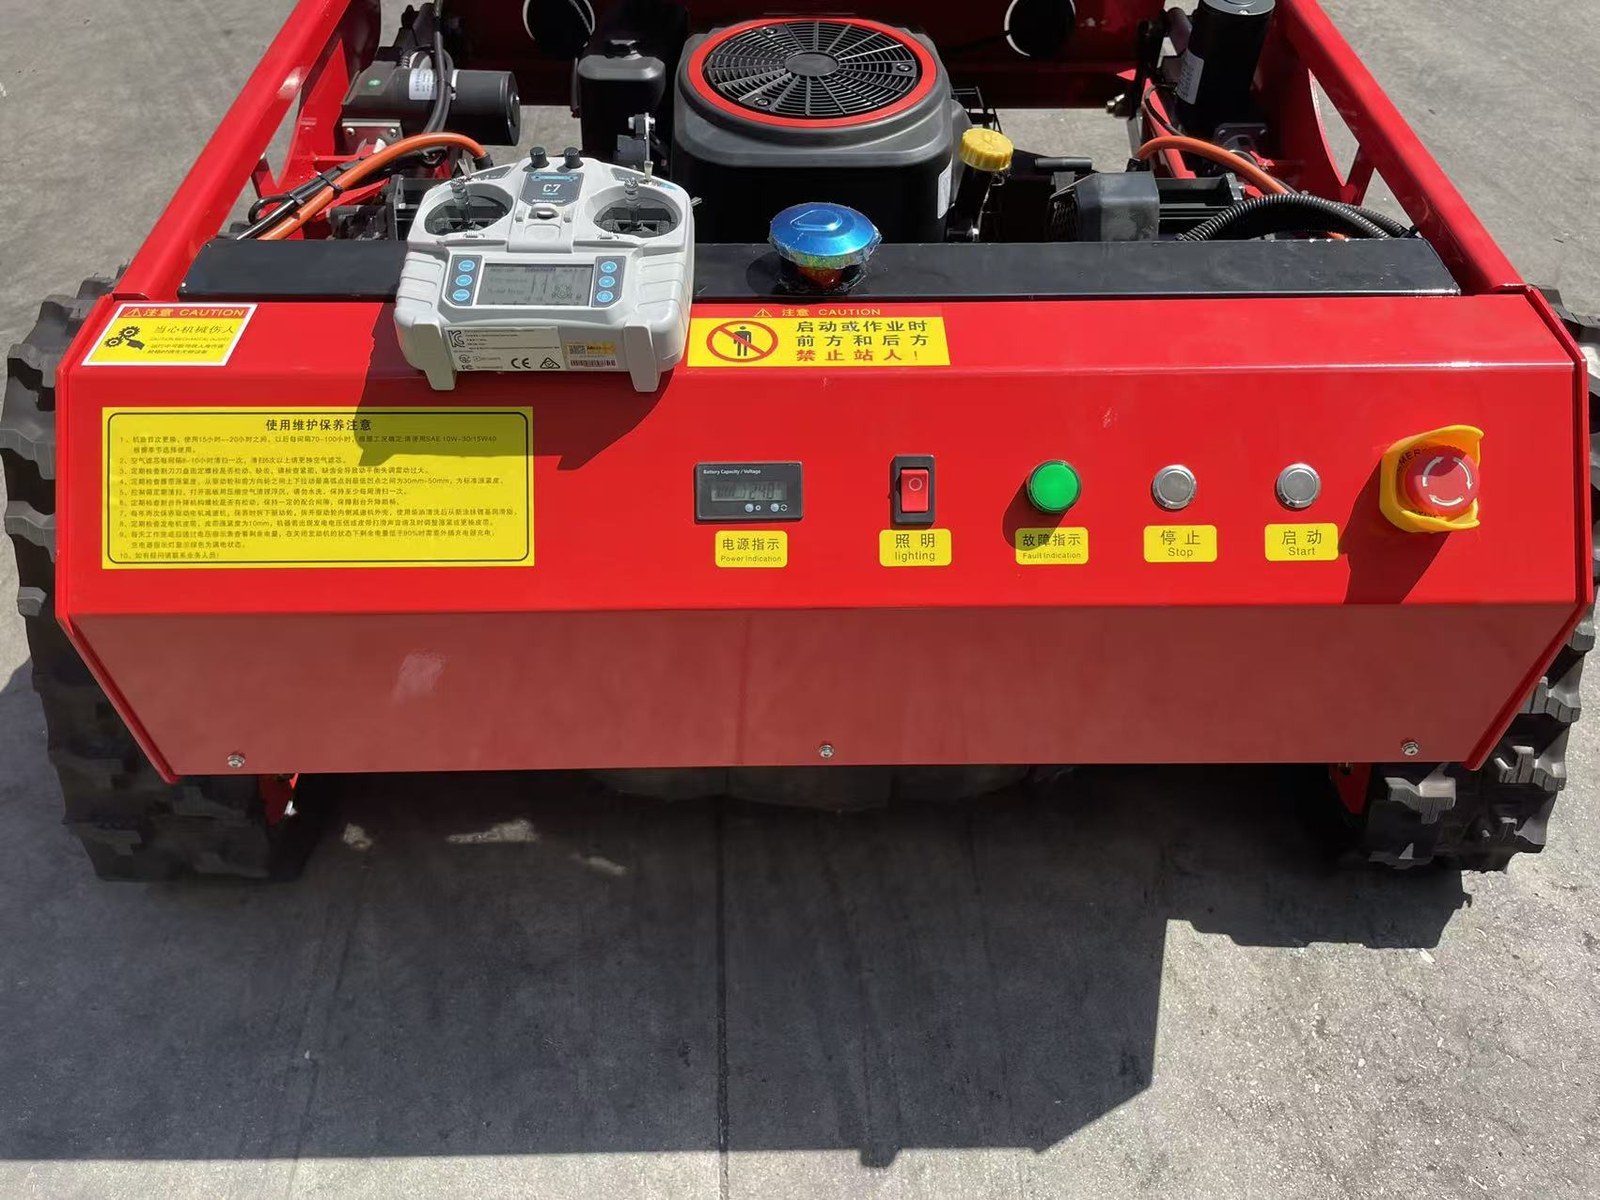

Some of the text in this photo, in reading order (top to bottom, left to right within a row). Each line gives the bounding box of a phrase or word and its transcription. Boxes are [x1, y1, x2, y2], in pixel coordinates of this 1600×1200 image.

[542, 183, 561, 193] C7
[143, 308, 245, 318] 注意 CAUTION
[781, 308, 882, 317] 注意 CAUTION
[154, 324, 234, 336] 当心机械伤人
[796, 320, 928, 333] 启动或作业时
[795, 334, 929, 348] 前方和后方
[795, 348, 918, 362] 禁止站人！
[510, 357, 532, 369] CE
[265, 418, 373, 432] 使用维护保养注意
[703, 469, 720, 477] Battery
[720, 469, 740, 477] Capacity
[743, 469, 761, 477] Voltage
[895, 533, 936, 549] 照明
[1022, 532, 1081, 547] 故障指示
[1160, 529, 1202, 546] 停止
[1281, 528, 1323, 546] 启动
[722, 537, 780, 552] 电源指示
[895, 551, 936, 563] lighting
[1022, 551, 1082, 560] Fault Indication
[1167, 546, 1194, 558] Stop
[1288, 545, 1316, 557] Start
[745, 554, 782, 562] Indication
